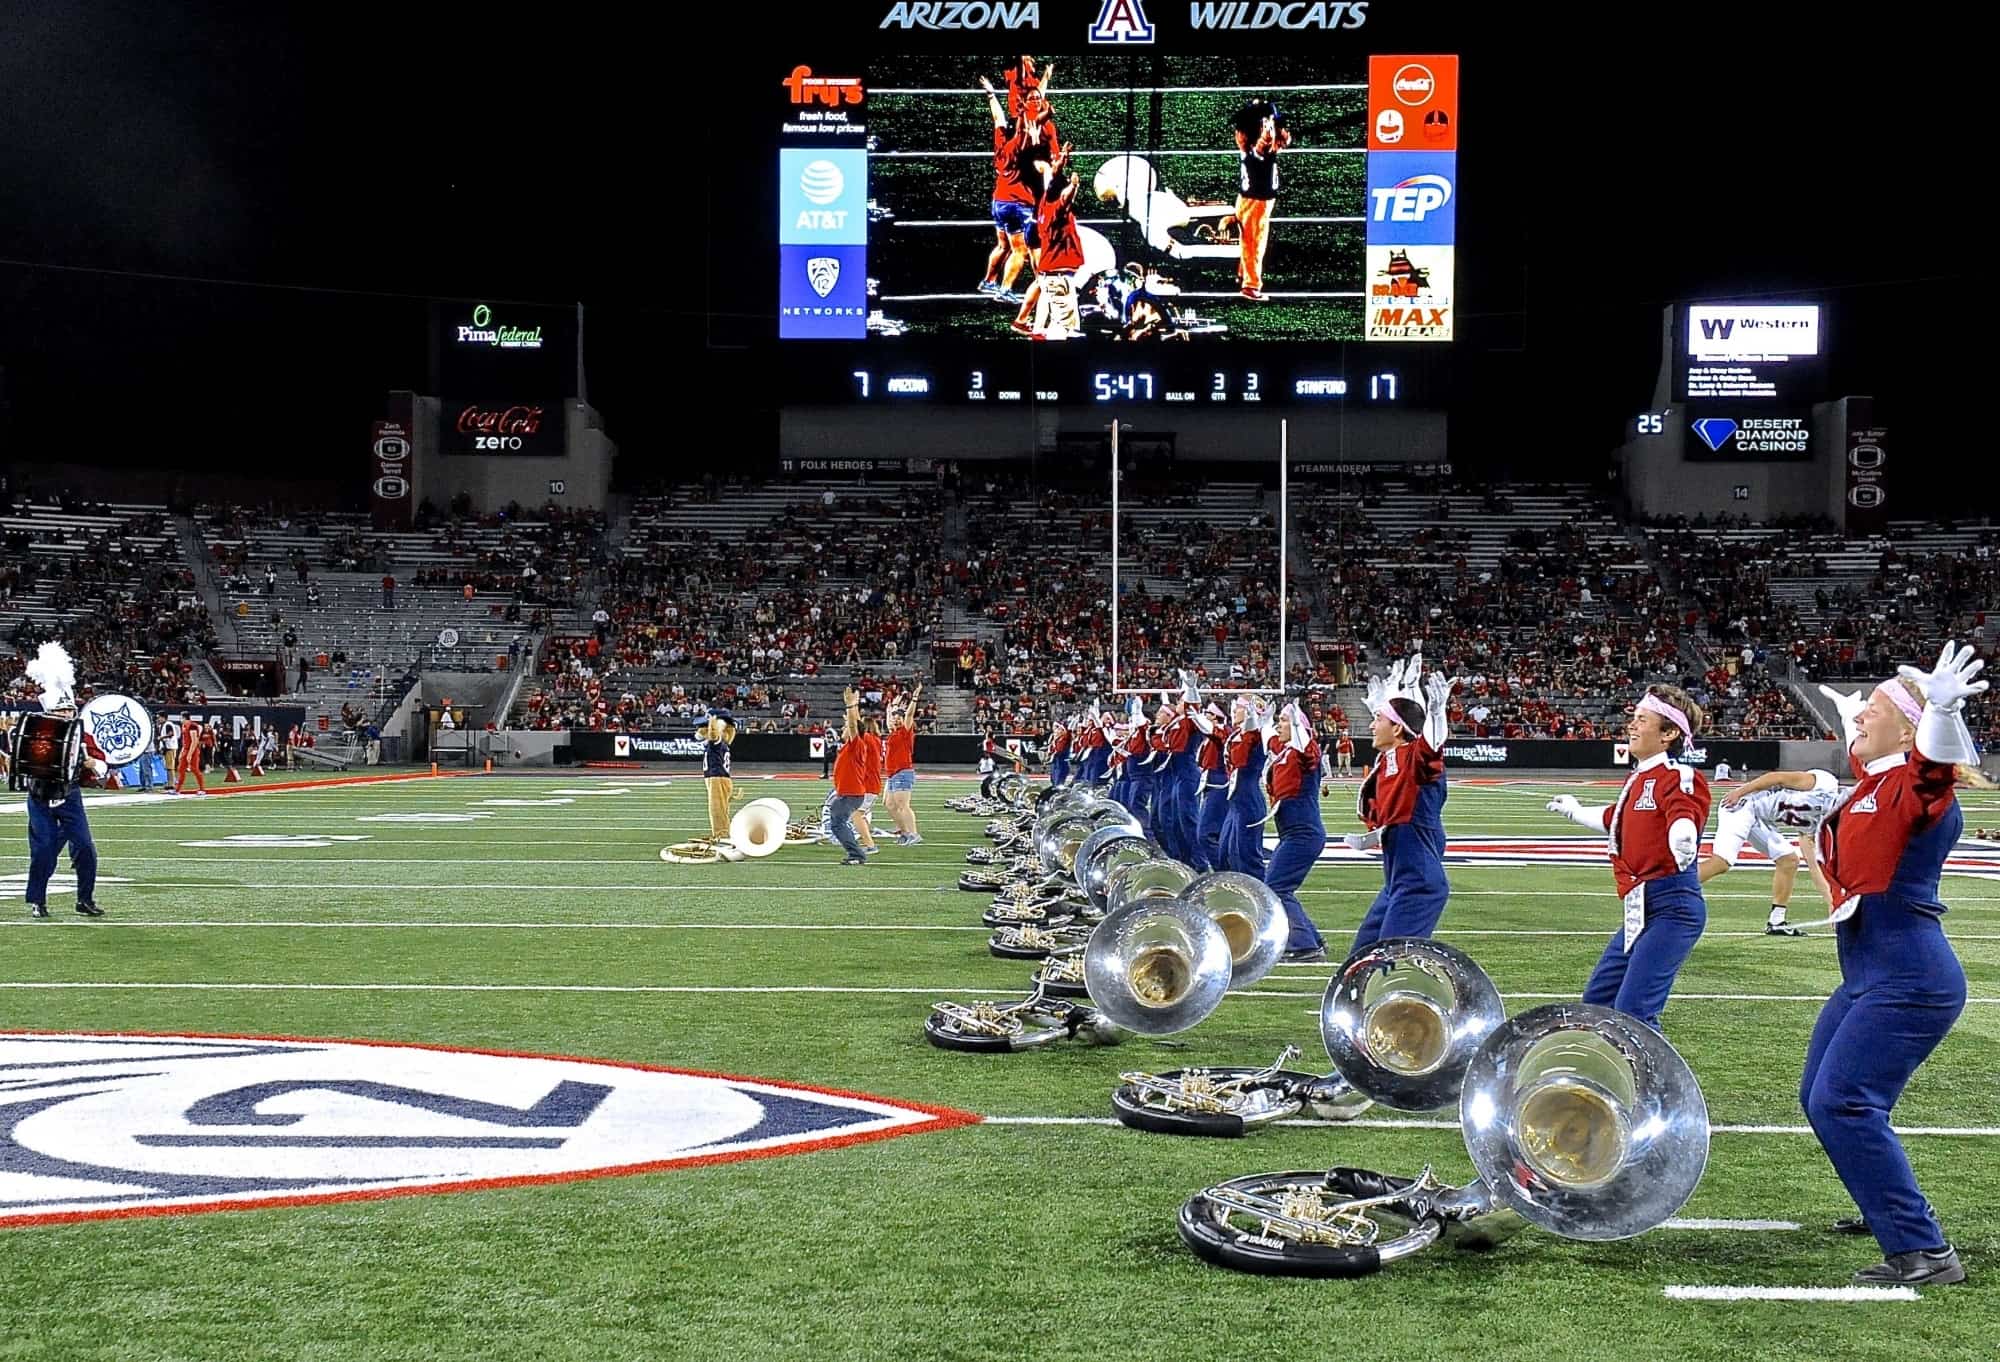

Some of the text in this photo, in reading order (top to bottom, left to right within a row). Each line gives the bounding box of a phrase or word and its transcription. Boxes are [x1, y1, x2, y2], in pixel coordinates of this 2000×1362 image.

[879, 1, 1040, 30] ARIZONA
[1088, 0, 1155, 43] A
[1190, 1, 1368, 30] WILDCATS
[782, 65, 863, 107] fry's
[1371, 187, 1444, 222] TEP
[796, 210, 848, 230] AT&T
[783, 307, 864, 316] NETWORKS
[1699, 318, 1809, 340] W Western
[853, 371, 869, 397] 7
[971, 371, 983, 389] 3
[1095, 373, 1153, 400] 5:47
[1213, 373, 1225, 390] 3
[1247, 373, 1259, 390] 3
[1296, 379, 1346, 395] STANFORD
[1370, 373, 1397, 400] 17
[998, 391, 1021, 400] DOWN
[1637, 414, 1663, 433] 25
[1742, 419, 1802, 429] DESERT
[475, 436, 522, 450] zero
[1735, 430, 1809, 440] DIAMOND
[1736, 441, 1807, 451] CASINOS
[782, 460, 793, 470] 11
[800, 460, 828, 470] FOLK
[830, 460, 873, 470] HEROES
[550, 482, 565, 493] 10
[1735, 487, 1748, 498] 14
